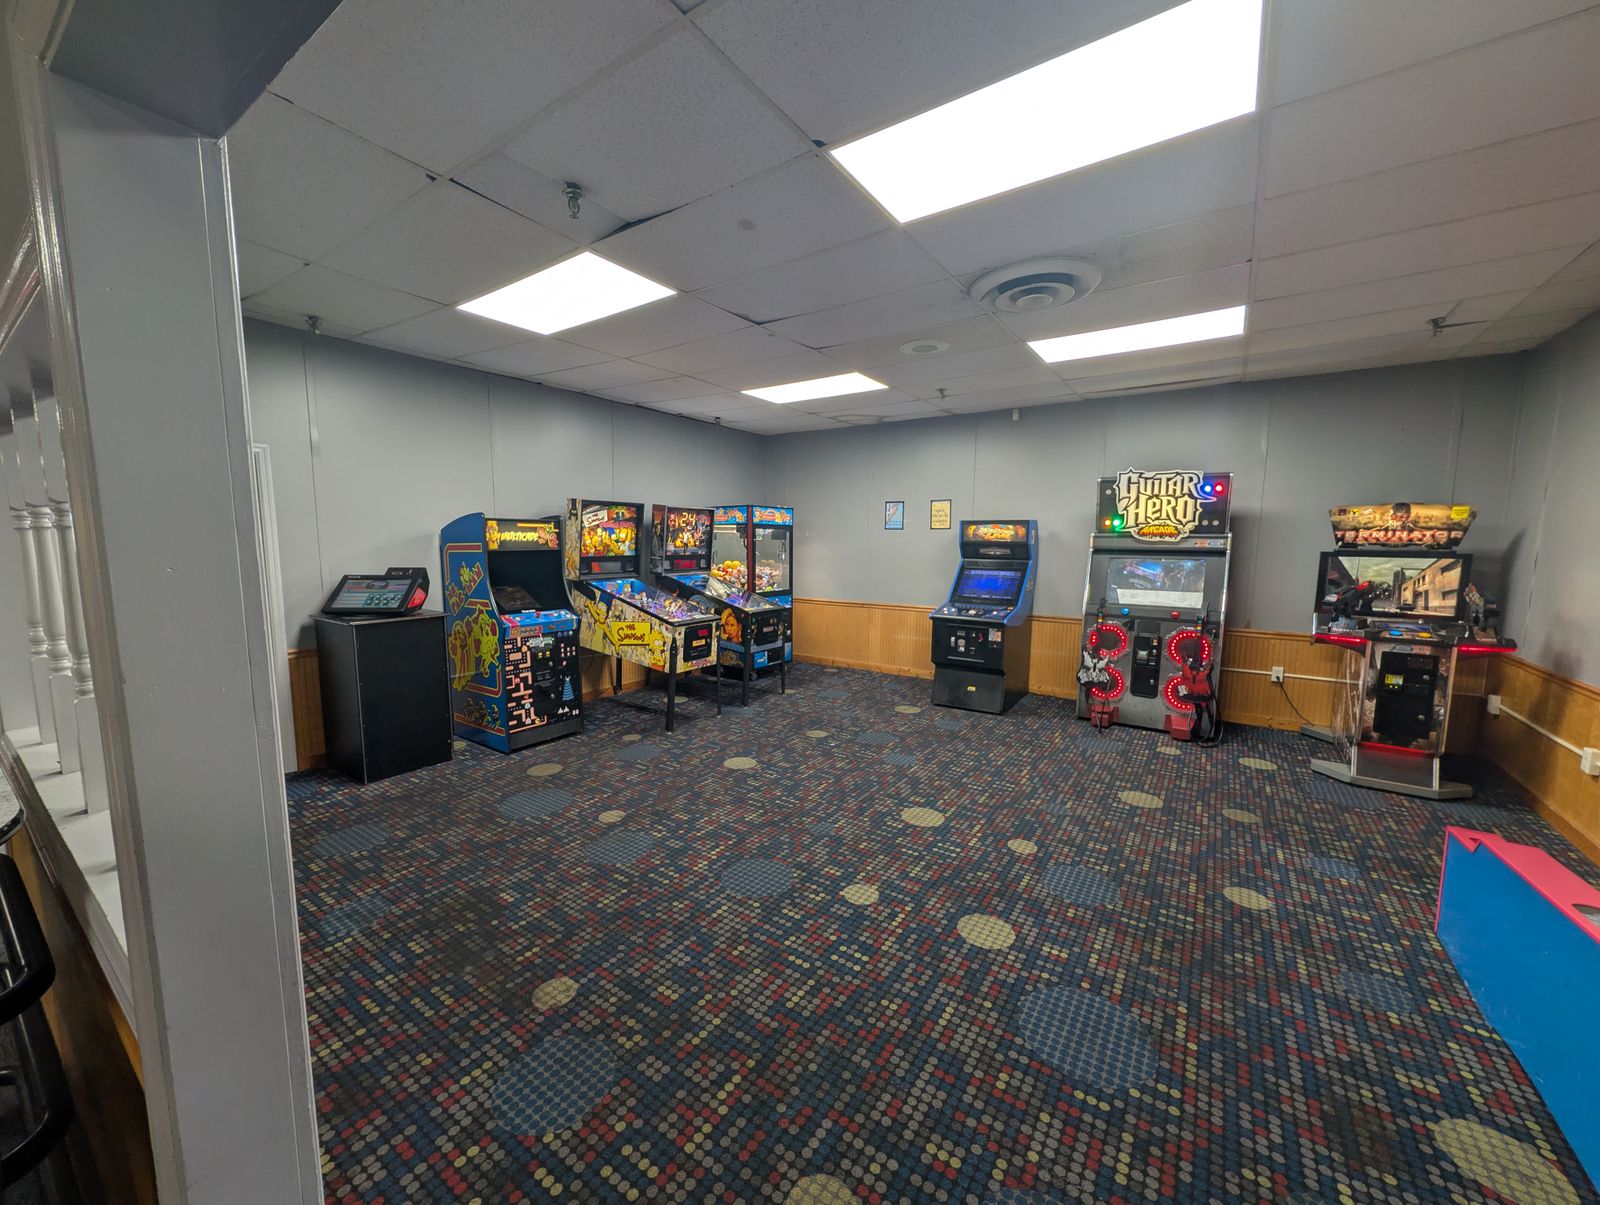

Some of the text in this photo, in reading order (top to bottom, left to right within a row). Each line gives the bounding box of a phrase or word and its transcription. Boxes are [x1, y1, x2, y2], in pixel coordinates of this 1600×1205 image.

[1117, 472, 1203, 503] GUITAR
[1125, 494, 1196, 527] HERO
[680, 512, 697, 527] 24
[1138, 524, 1179, 536] ARCADE
[1334, 529, 1465, 540] TERMINATOR
